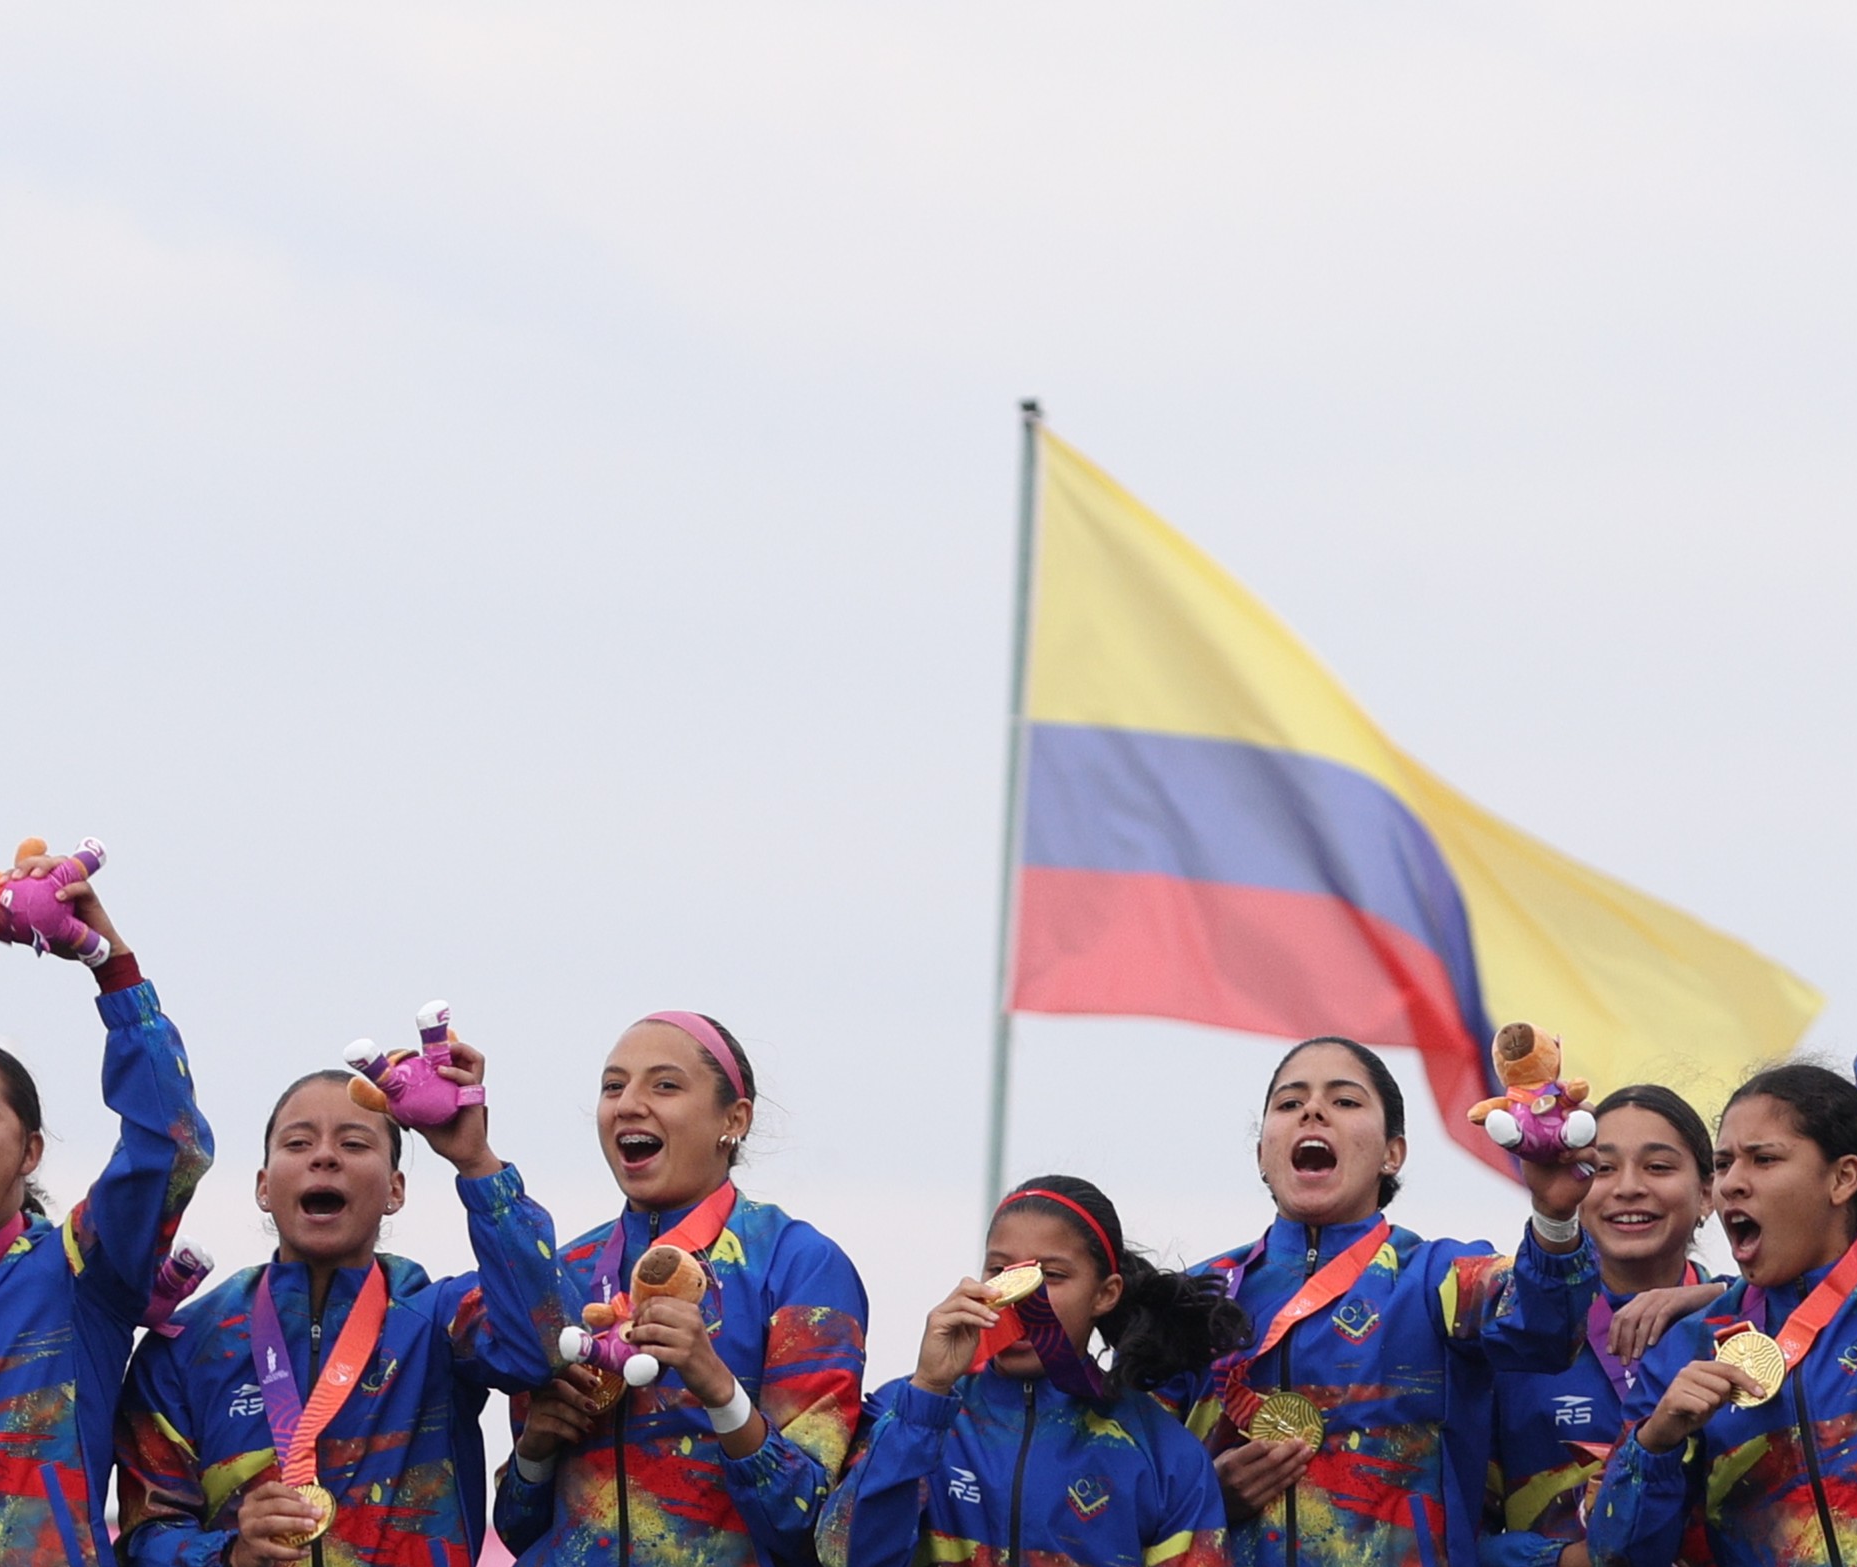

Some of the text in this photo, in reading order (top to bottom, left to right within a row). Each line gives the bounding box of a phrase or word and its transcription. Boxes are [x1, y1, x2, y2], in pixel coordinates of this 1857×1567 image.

[229, 1397, 264, 1417] RS
[1556, 1407, 1592, 1425] RS
[949, 1480, 980, 1503] RS
